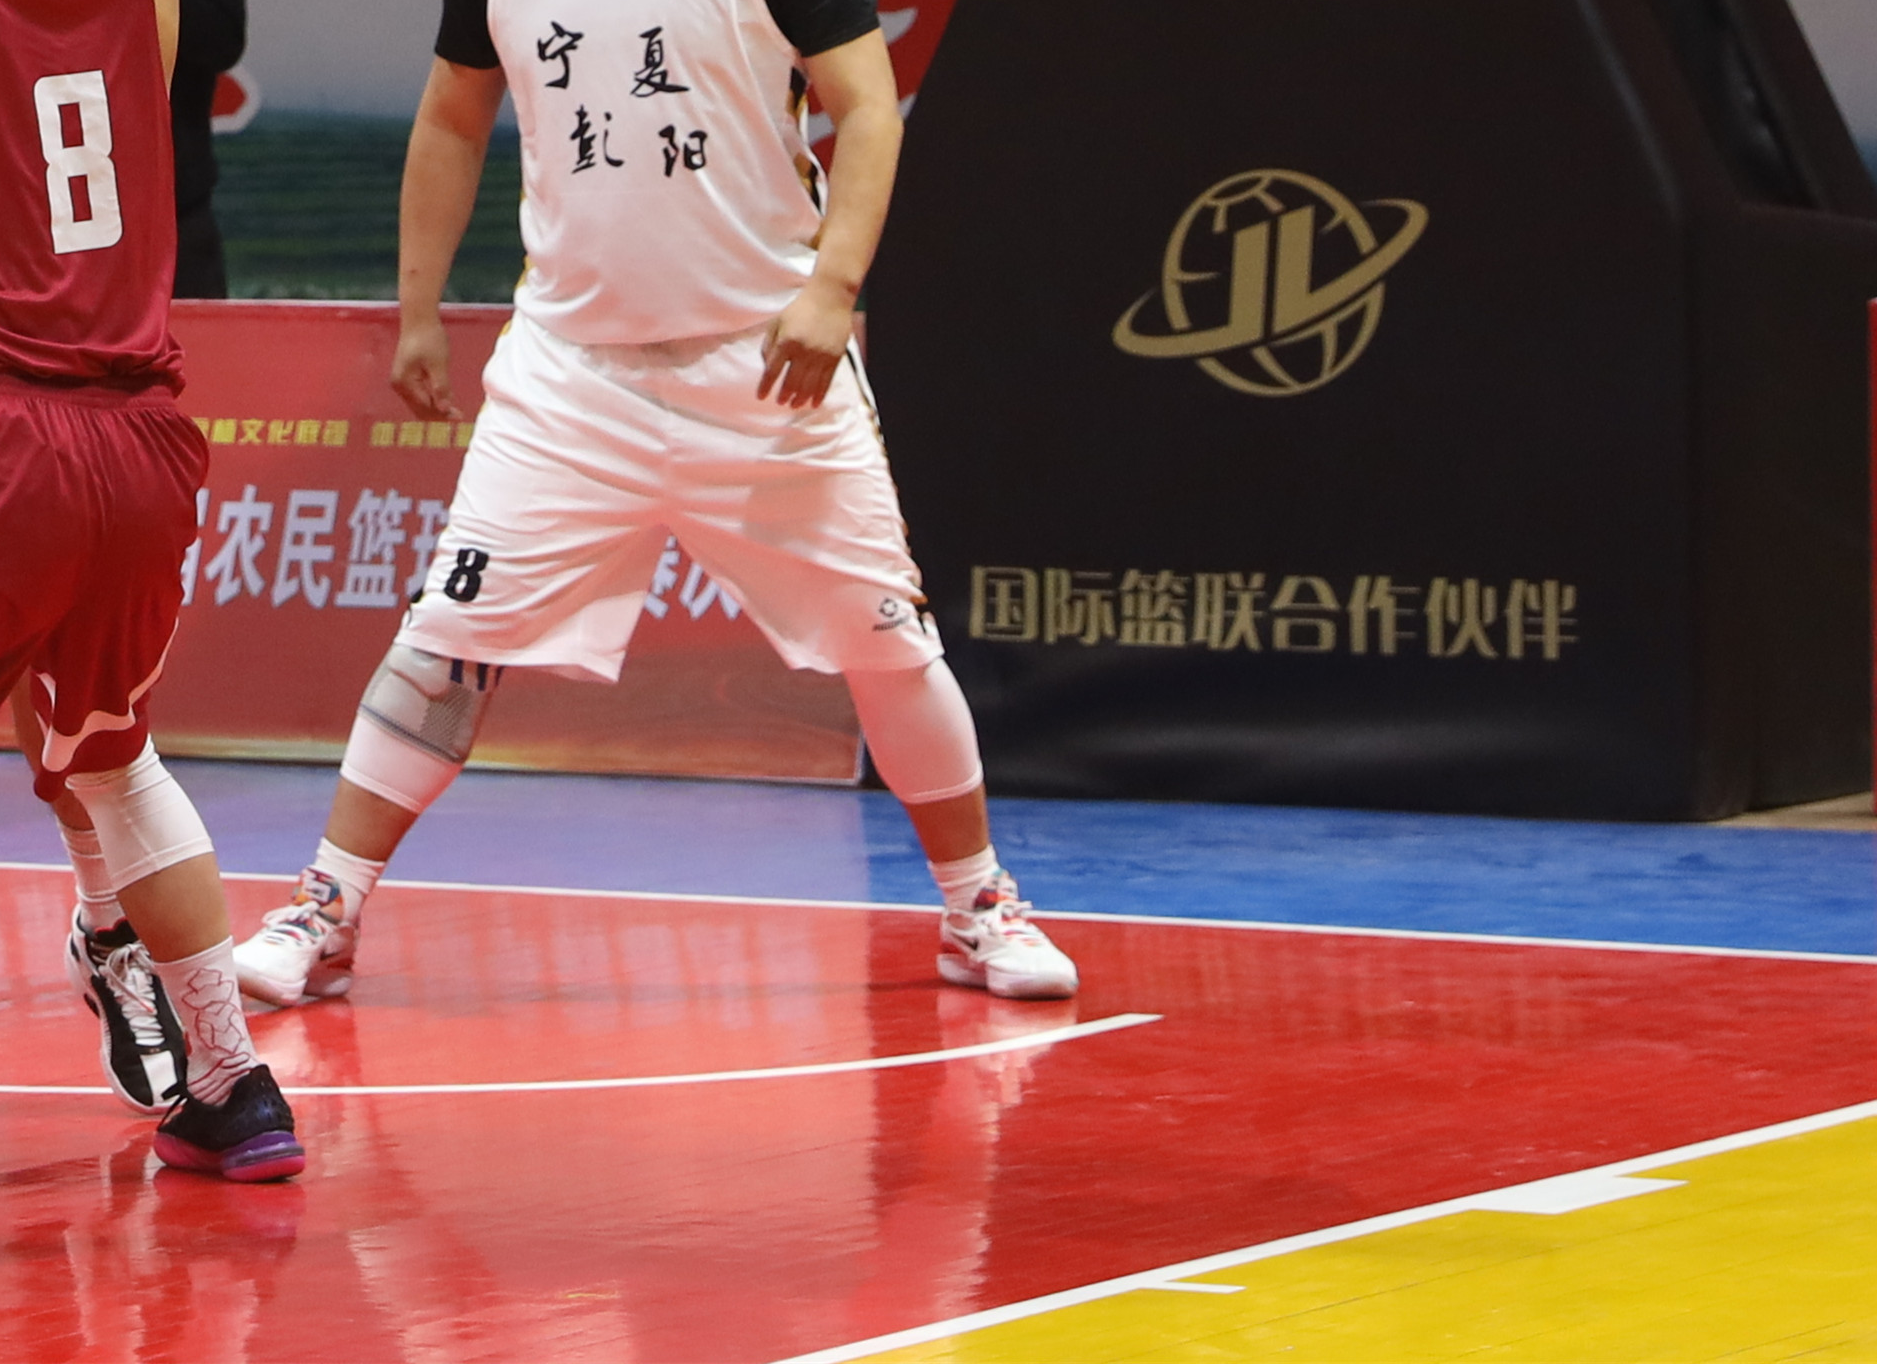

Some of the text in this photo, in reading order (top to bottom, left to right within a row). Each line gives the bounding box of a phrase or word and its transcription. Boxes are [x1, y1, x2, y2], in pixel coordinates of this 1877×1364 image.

[536, 21, 689, 98] 宁夏
[34, 69, 124, 255] 8
[569, 105, 712, 178] 彭阳
[443, 548, 490, 603] 8
[968, 564, 1579, 662] 国际篮联合作伙伴
